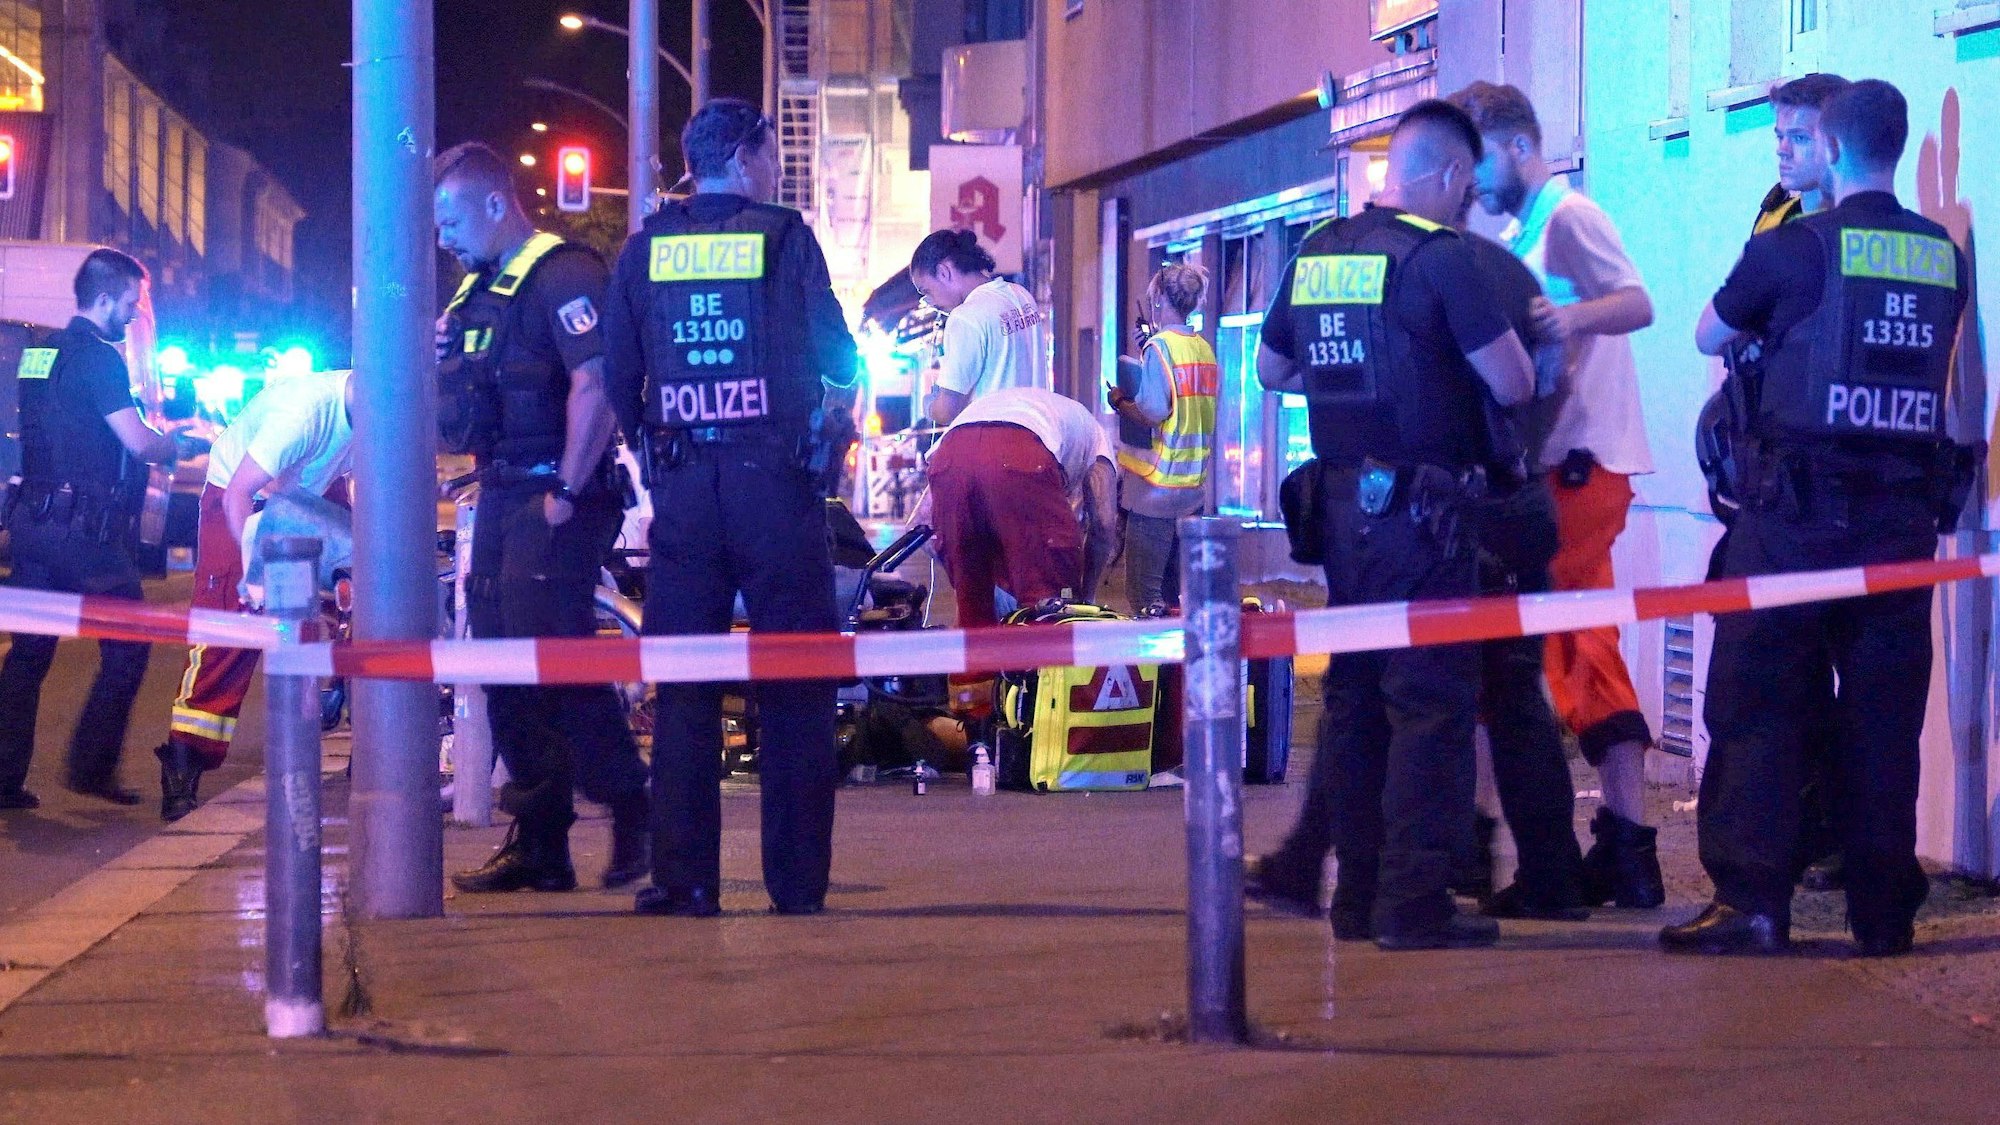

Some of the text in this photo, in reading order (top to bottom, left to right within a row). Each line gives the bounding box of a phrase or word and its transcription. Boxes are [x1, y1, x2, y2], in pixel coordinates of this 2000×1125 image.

[655, 240, 757, 275] POLIZEI
[1846, 232, 1953, 281] POLIZEI
[1295, 260, 1382, 299] POLIZEI
[690, 293, 723, 317] BE
[1885, 291, 1918, 319] BE
[673, 319, 745, 343] 13100
[1320, 312, 1346, 337] BE
[1863, 319, 1934, 348] 13315
[1308, 339, 1365, 366] 13314
[661, 378, 768, 422] POLIZEI
[1827, 383, 1938, 433] POLIZEI
